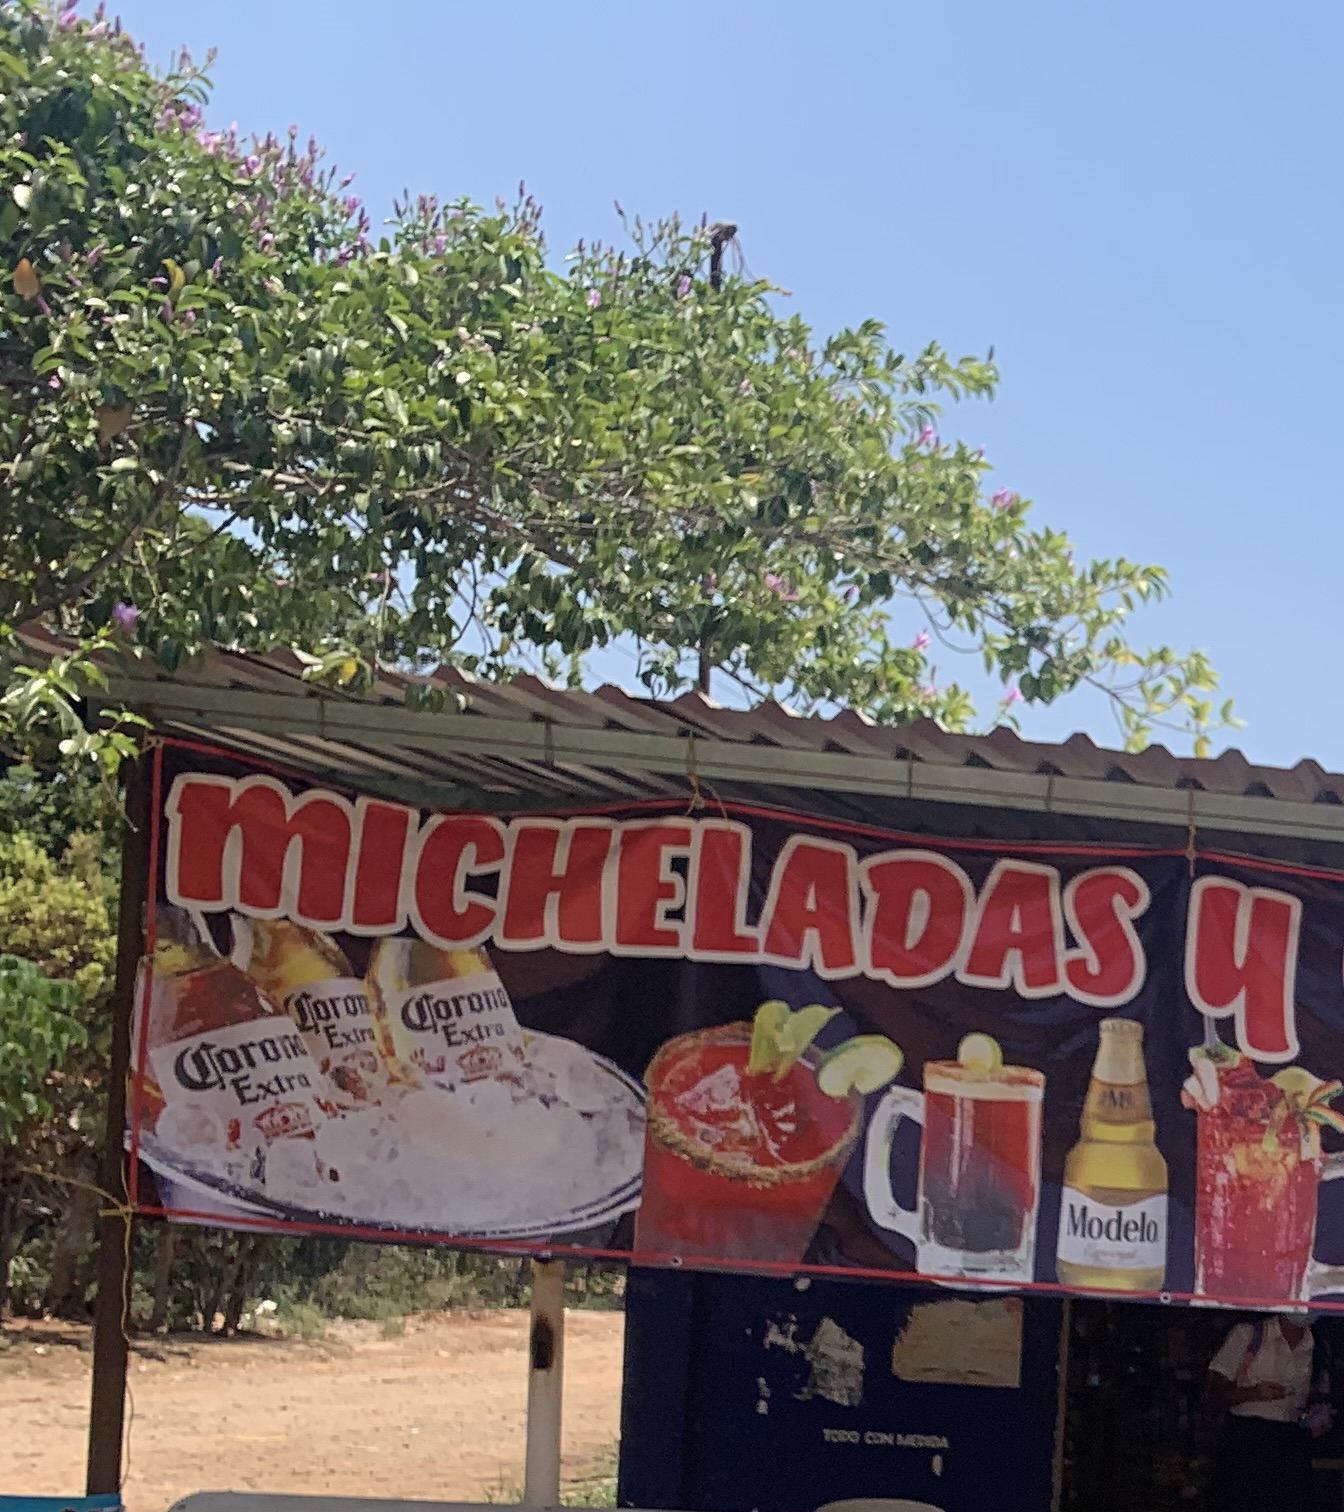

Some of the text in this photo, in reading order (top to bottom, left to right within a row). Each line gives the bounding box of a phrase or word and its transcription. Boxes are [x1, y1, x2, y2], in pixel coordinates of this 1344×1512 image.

[164, 772, 1151, 1008] MICHELADAS
[401, 986, 508, 1034] Corona
[442, 1020, 506, 1048] Extra
[174, 1031, 308, 1093] Corona
[230, 1072, 312, 1106] Extra
[1066, 1202, 1160, 1244] Modelo
